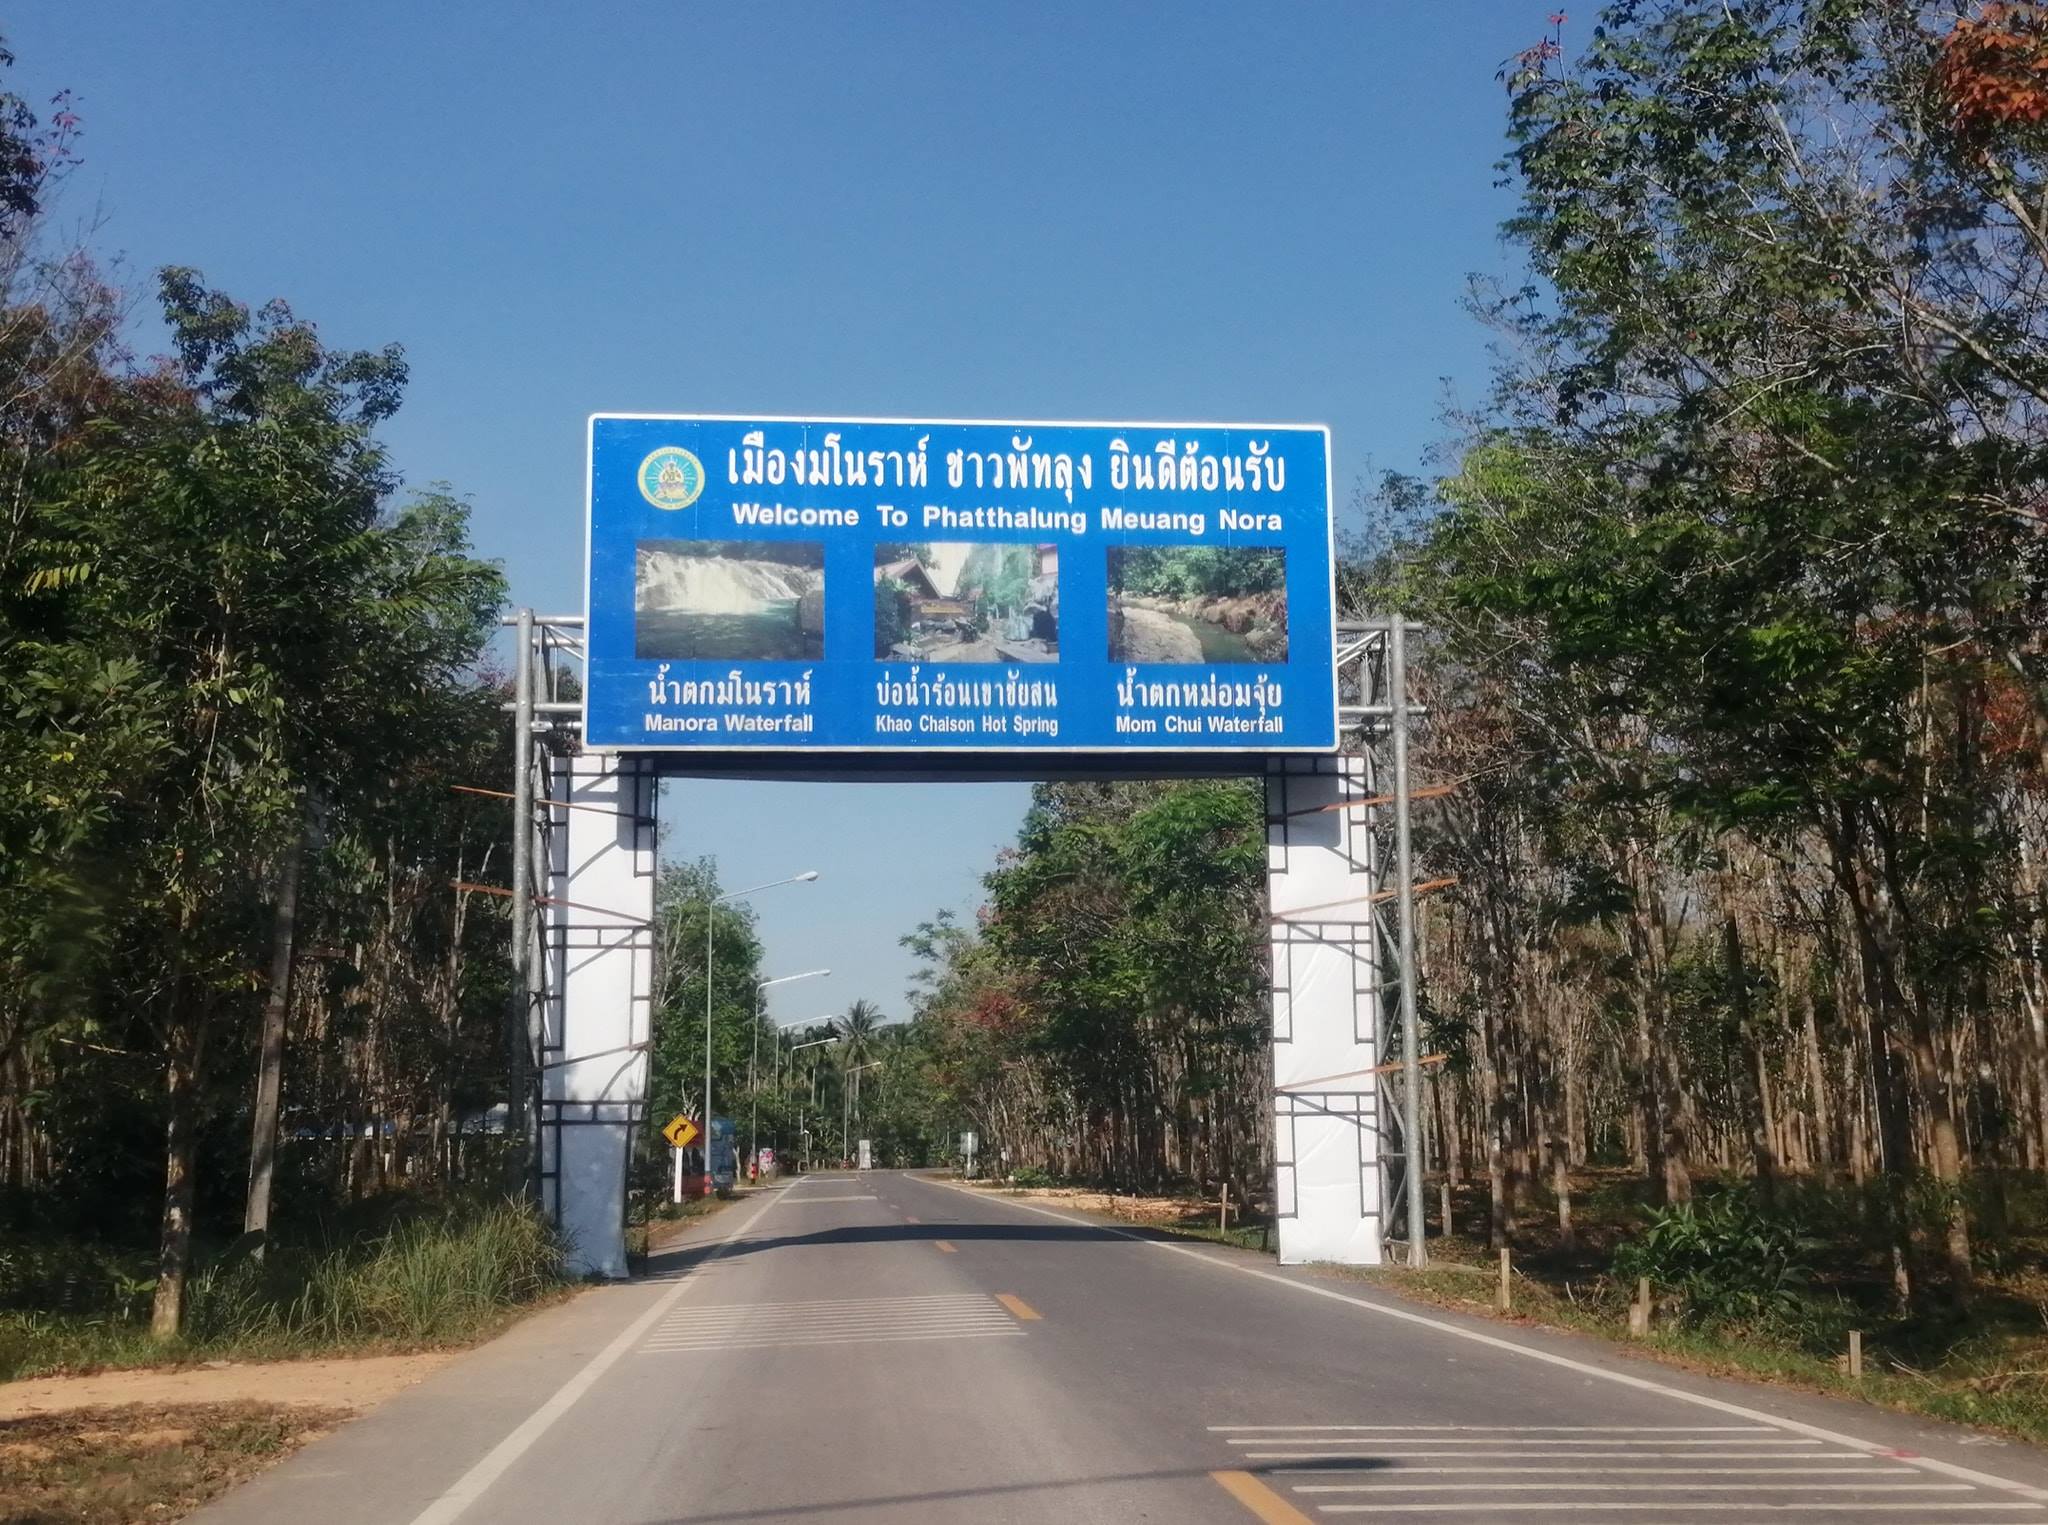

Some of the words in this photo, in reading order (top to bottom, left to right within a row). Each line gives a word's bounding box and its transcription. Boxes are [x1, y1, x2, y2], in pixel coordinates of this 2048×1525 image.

[728, 430, 931, 487] เมืองมโนราห์
[946, 435, 1093, 503] ชาวพัทลุง
[1109, 438, 1286, 492] ยินดีต้อนรับ
[732, 503, 860, 526] Welcome
[876, 505, 909, 527] To
[923, 506, 1087, 534] Phatthalung
[1101, 508, 1206, 535] Meuang
[1219, 509, 1283, 531] Nora
[649, 663, 813, 705] น้ำตกมโนราห์
[876, 665, 1058, 707] บ่อน้ำร้อนเขาชัยสน
[1117, 667, 1282, 717] น้ำตกหม่อมจุ้ย
[645, 714, 718, 732] Manora
[724, 714, 813, 732] Waterfall
[875, 715, 912, 733] Khao
[919, 715, 975, 733] Chaison
[982, 715, 1007, 733] Hot
[1013, 715, 1059, 737] Spring
[1115, 716, 1157, 733] Mom
[1164, 716, 1202, 733] Chui
[1207, 716, 1283, 733] Waterfall
